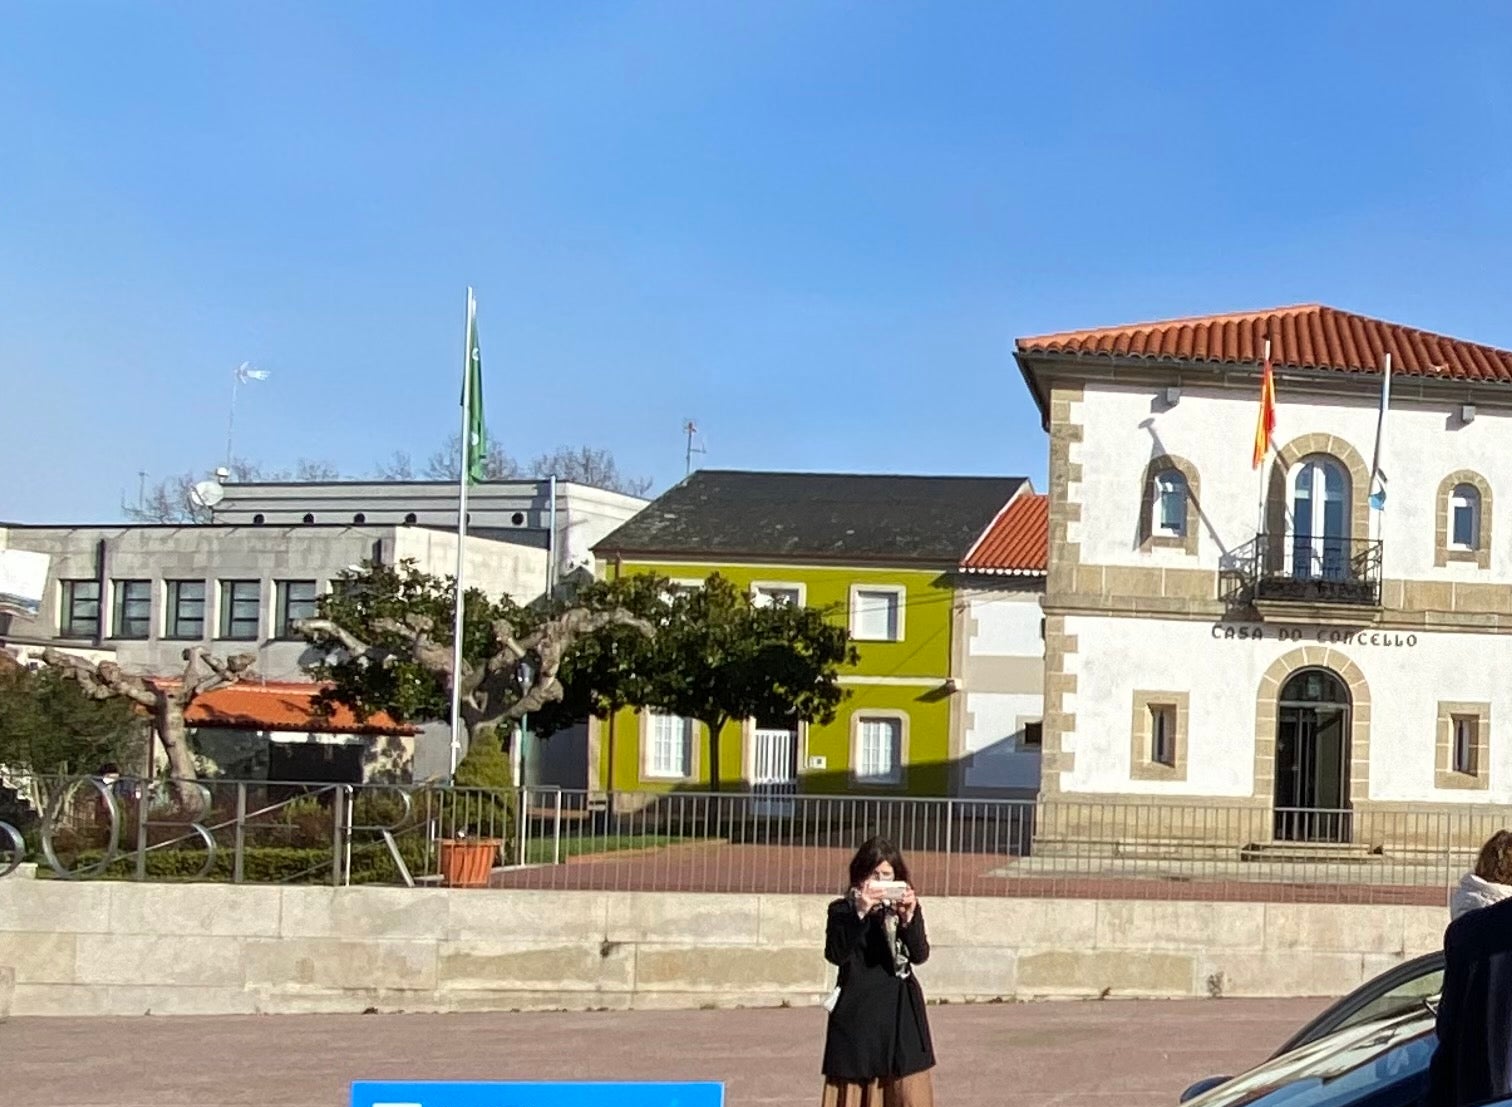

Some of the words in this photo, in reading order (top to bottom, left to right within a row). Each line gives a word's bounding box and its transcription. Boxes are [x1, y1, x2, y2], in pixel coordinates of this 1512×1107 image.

[1211, 625, 1264, 641] CASA
[1278, 627, 1303, 642] DO
[1317, 629, 1418, 647] CONCELLO
